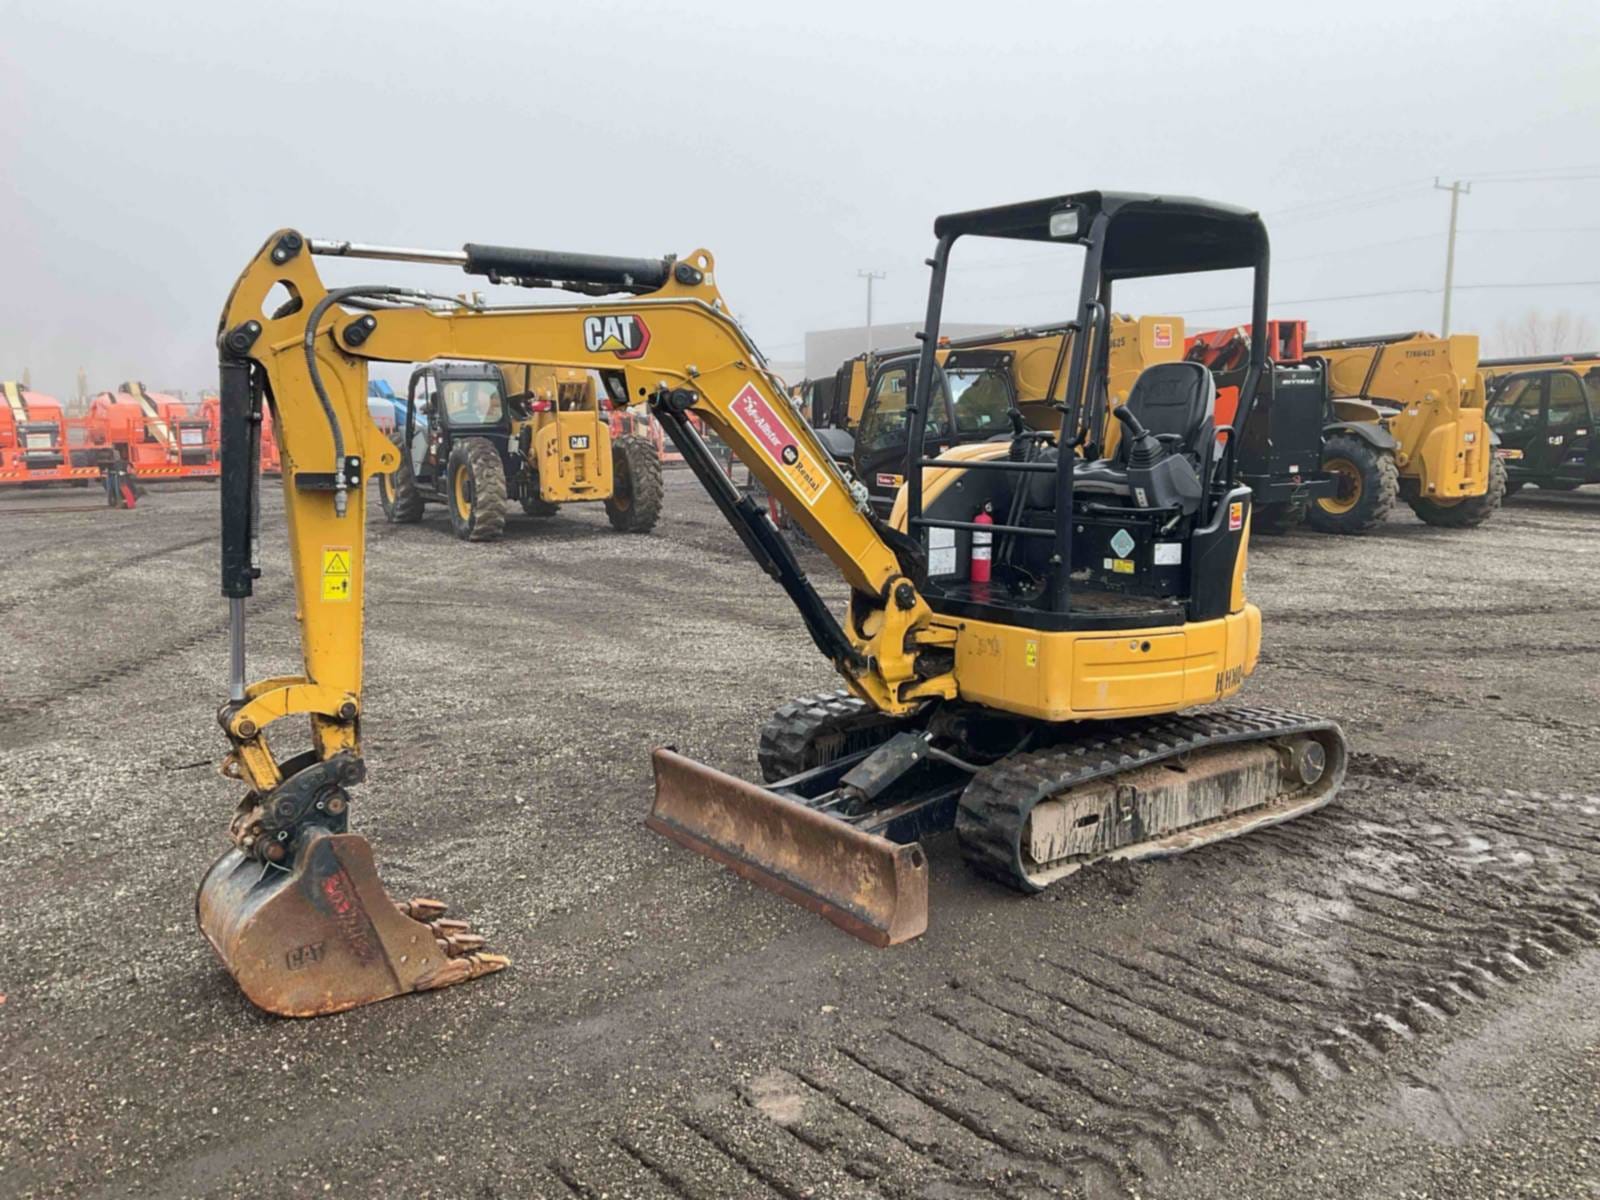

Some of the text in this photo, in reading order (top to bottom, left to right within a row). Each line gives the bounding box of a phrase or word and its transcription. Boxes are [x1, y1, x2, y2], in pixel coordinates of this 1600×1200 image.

[584, 316, 634, 351] CAT
[571, 436, 588, 448] CAT
[1548, 435, 1563, 445] CAT
[795, 462, 820, 491] Rental
[286, 942, 325, 970] CAT
